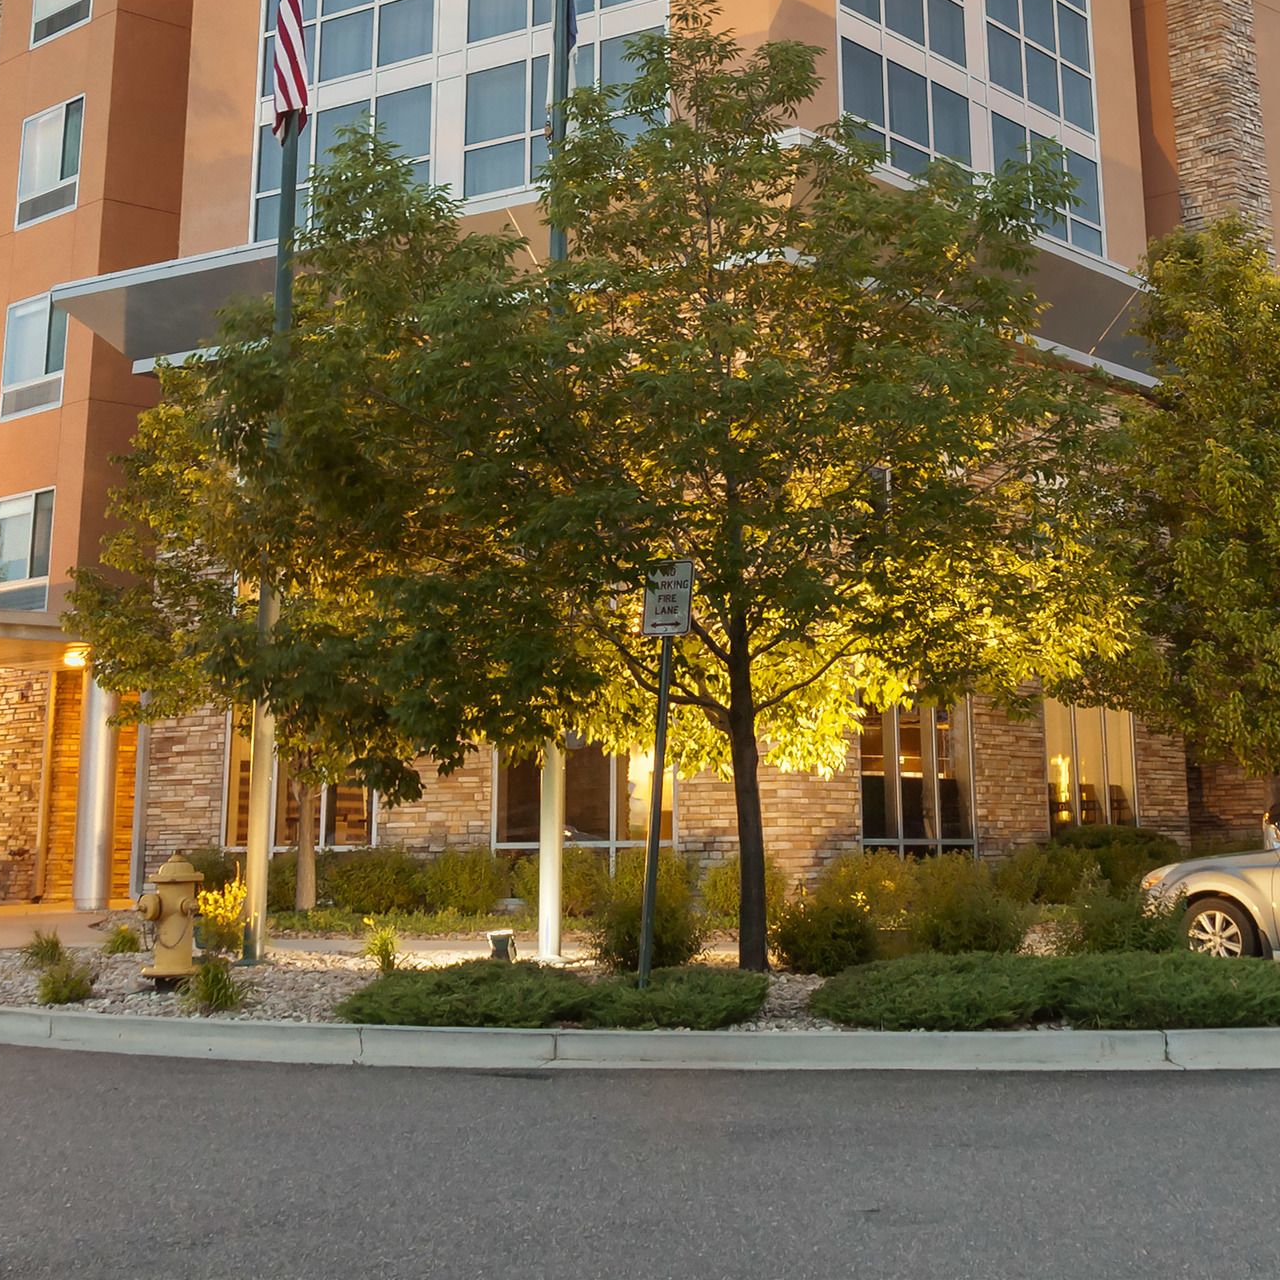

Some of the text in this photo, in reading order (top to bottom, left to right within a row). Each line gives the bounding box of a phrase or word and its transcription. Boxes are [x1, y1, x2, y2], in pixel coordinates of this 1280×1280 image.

[651, 580, 689, 590] ARKING
[657, 593, 677, 603] FIRE
[654, 605, 679, 615] LANE
